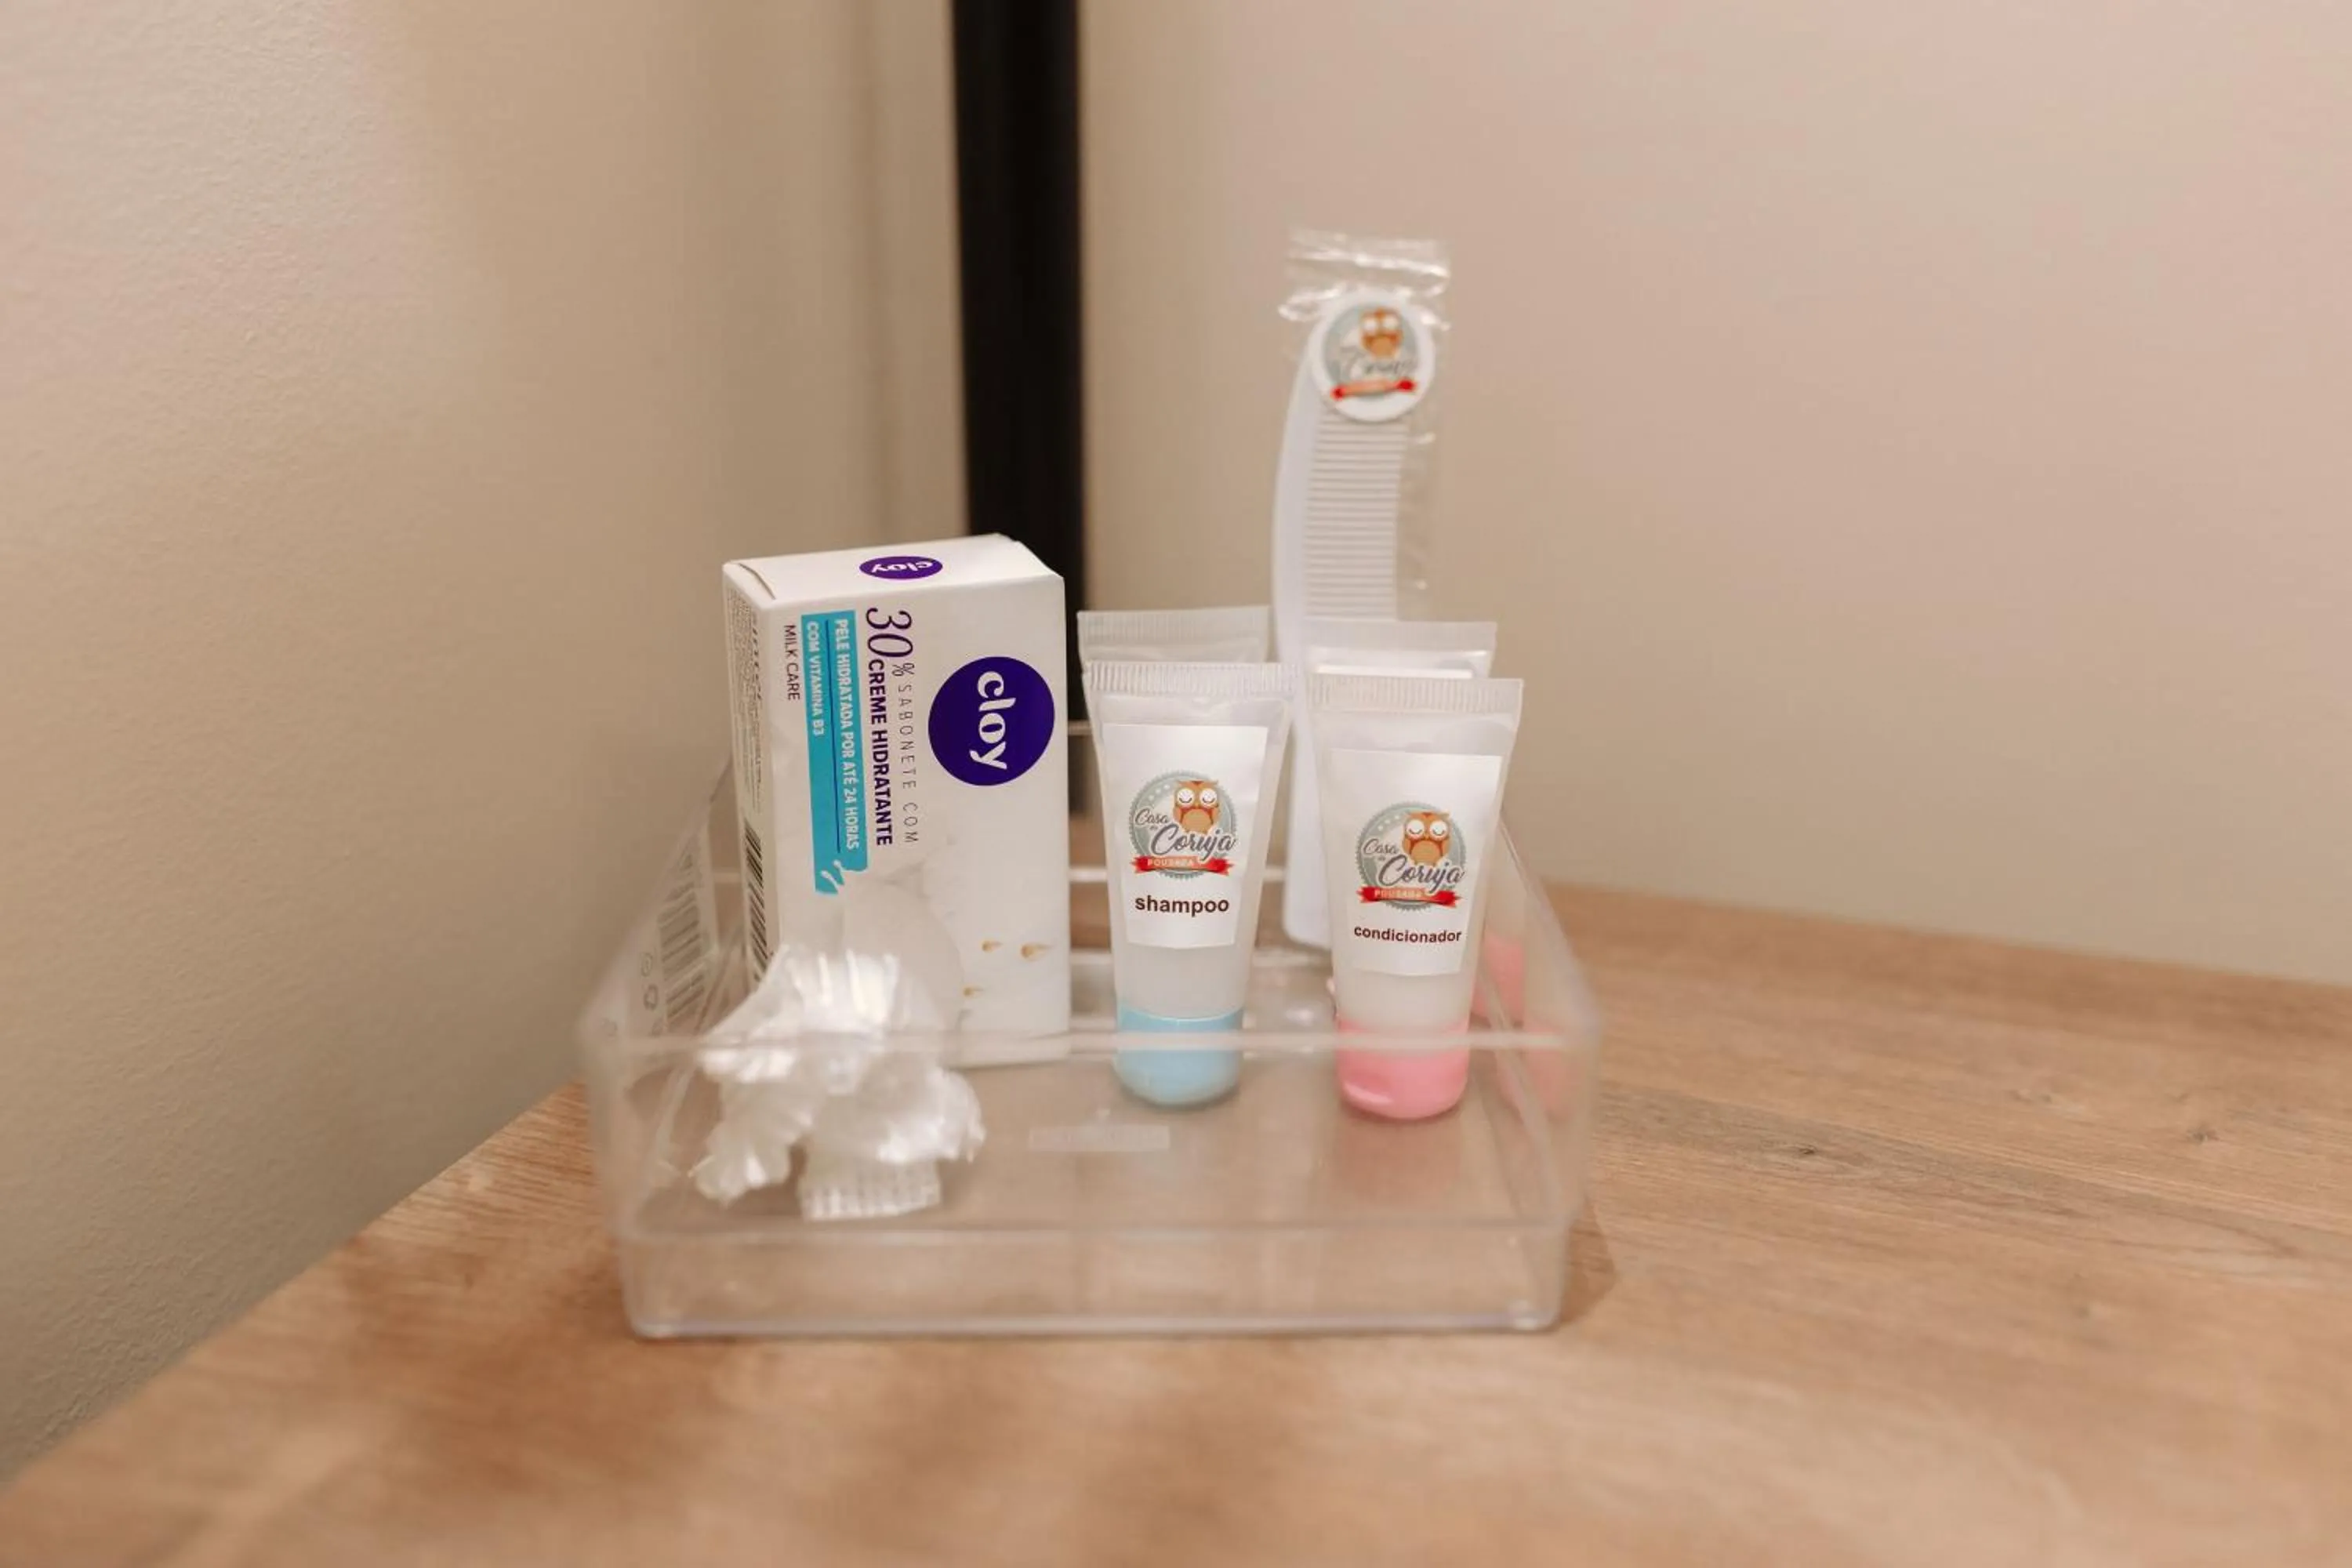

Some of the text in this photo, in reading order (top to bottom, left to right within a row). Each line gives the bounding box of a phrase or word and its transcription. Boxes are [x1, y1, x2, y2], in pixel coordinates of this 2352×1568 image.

[871, 561, 933, 572] cloy
[784, 625, 800, 701] MILK CARE
[807, 621, 824, 736] COM VITAMINA B3
[835, 619, 860, 849] PELE HIDRATADA POR ATÉ 24 HORAS
[970, 671, 1016, 770] cloy
[868, 659, 892, 846] CREME HIDRATANTE
[898, 684, 918, 843] SABONETE COM
[1134, 808, 1168, 826] Casa
[1150, 823, 1236, 862] Coruja
[1363, 838, 1399, 855] Casa
[1379, 855, 1465, 894] Coruja
[1134, 895, 1230, 917] shampoo
[1354, 926, 1463, 943] condicionador
